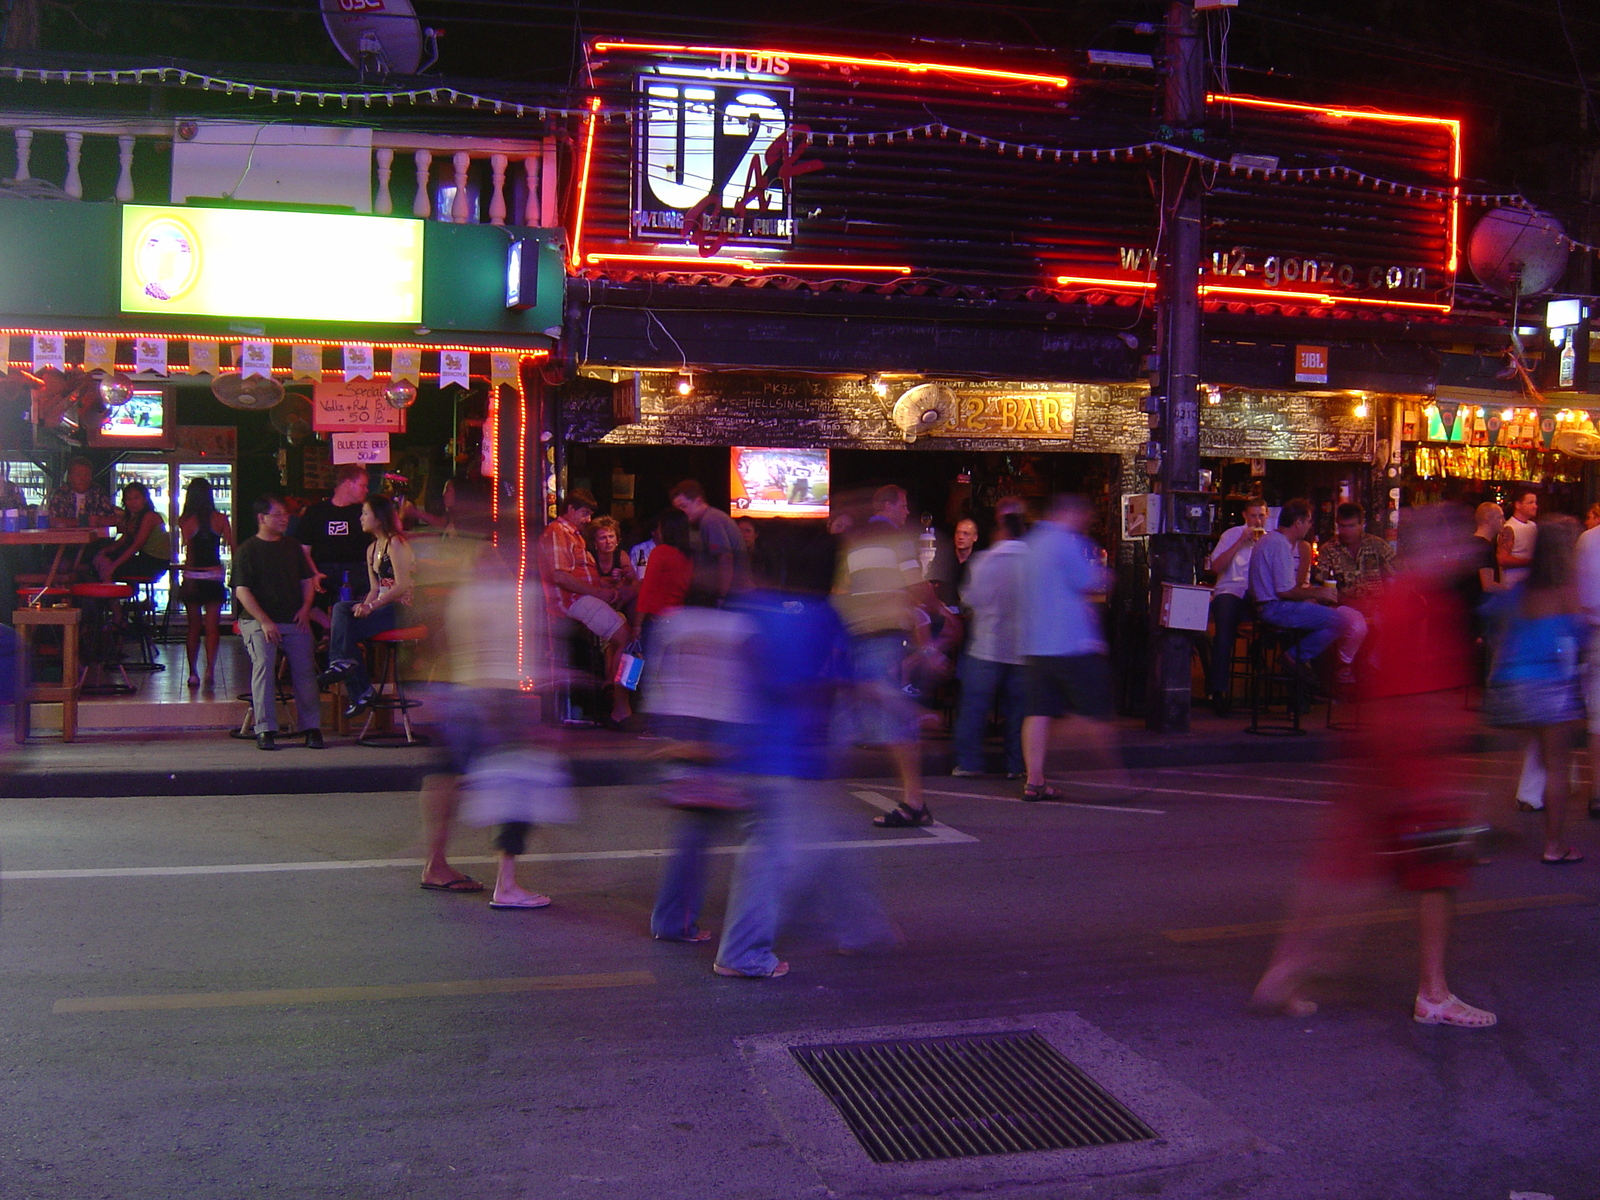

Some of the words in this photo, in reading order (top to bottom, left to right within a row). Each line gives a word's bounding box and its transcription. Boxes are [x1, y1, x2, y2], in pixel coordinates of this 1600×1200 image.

[702, 213, 744, 234] BEACH
[753, 218, 799, 236] PHUKET
[1301, 352, 1324, 368] JBL
[349, 411, 370, 423] 50
[1000, 397, 1062, 431] BAR
[338, 440, 355, 450] BLUE
[356, 440, 368, 449] ICE
[372, 439, 388, 449] BEER
